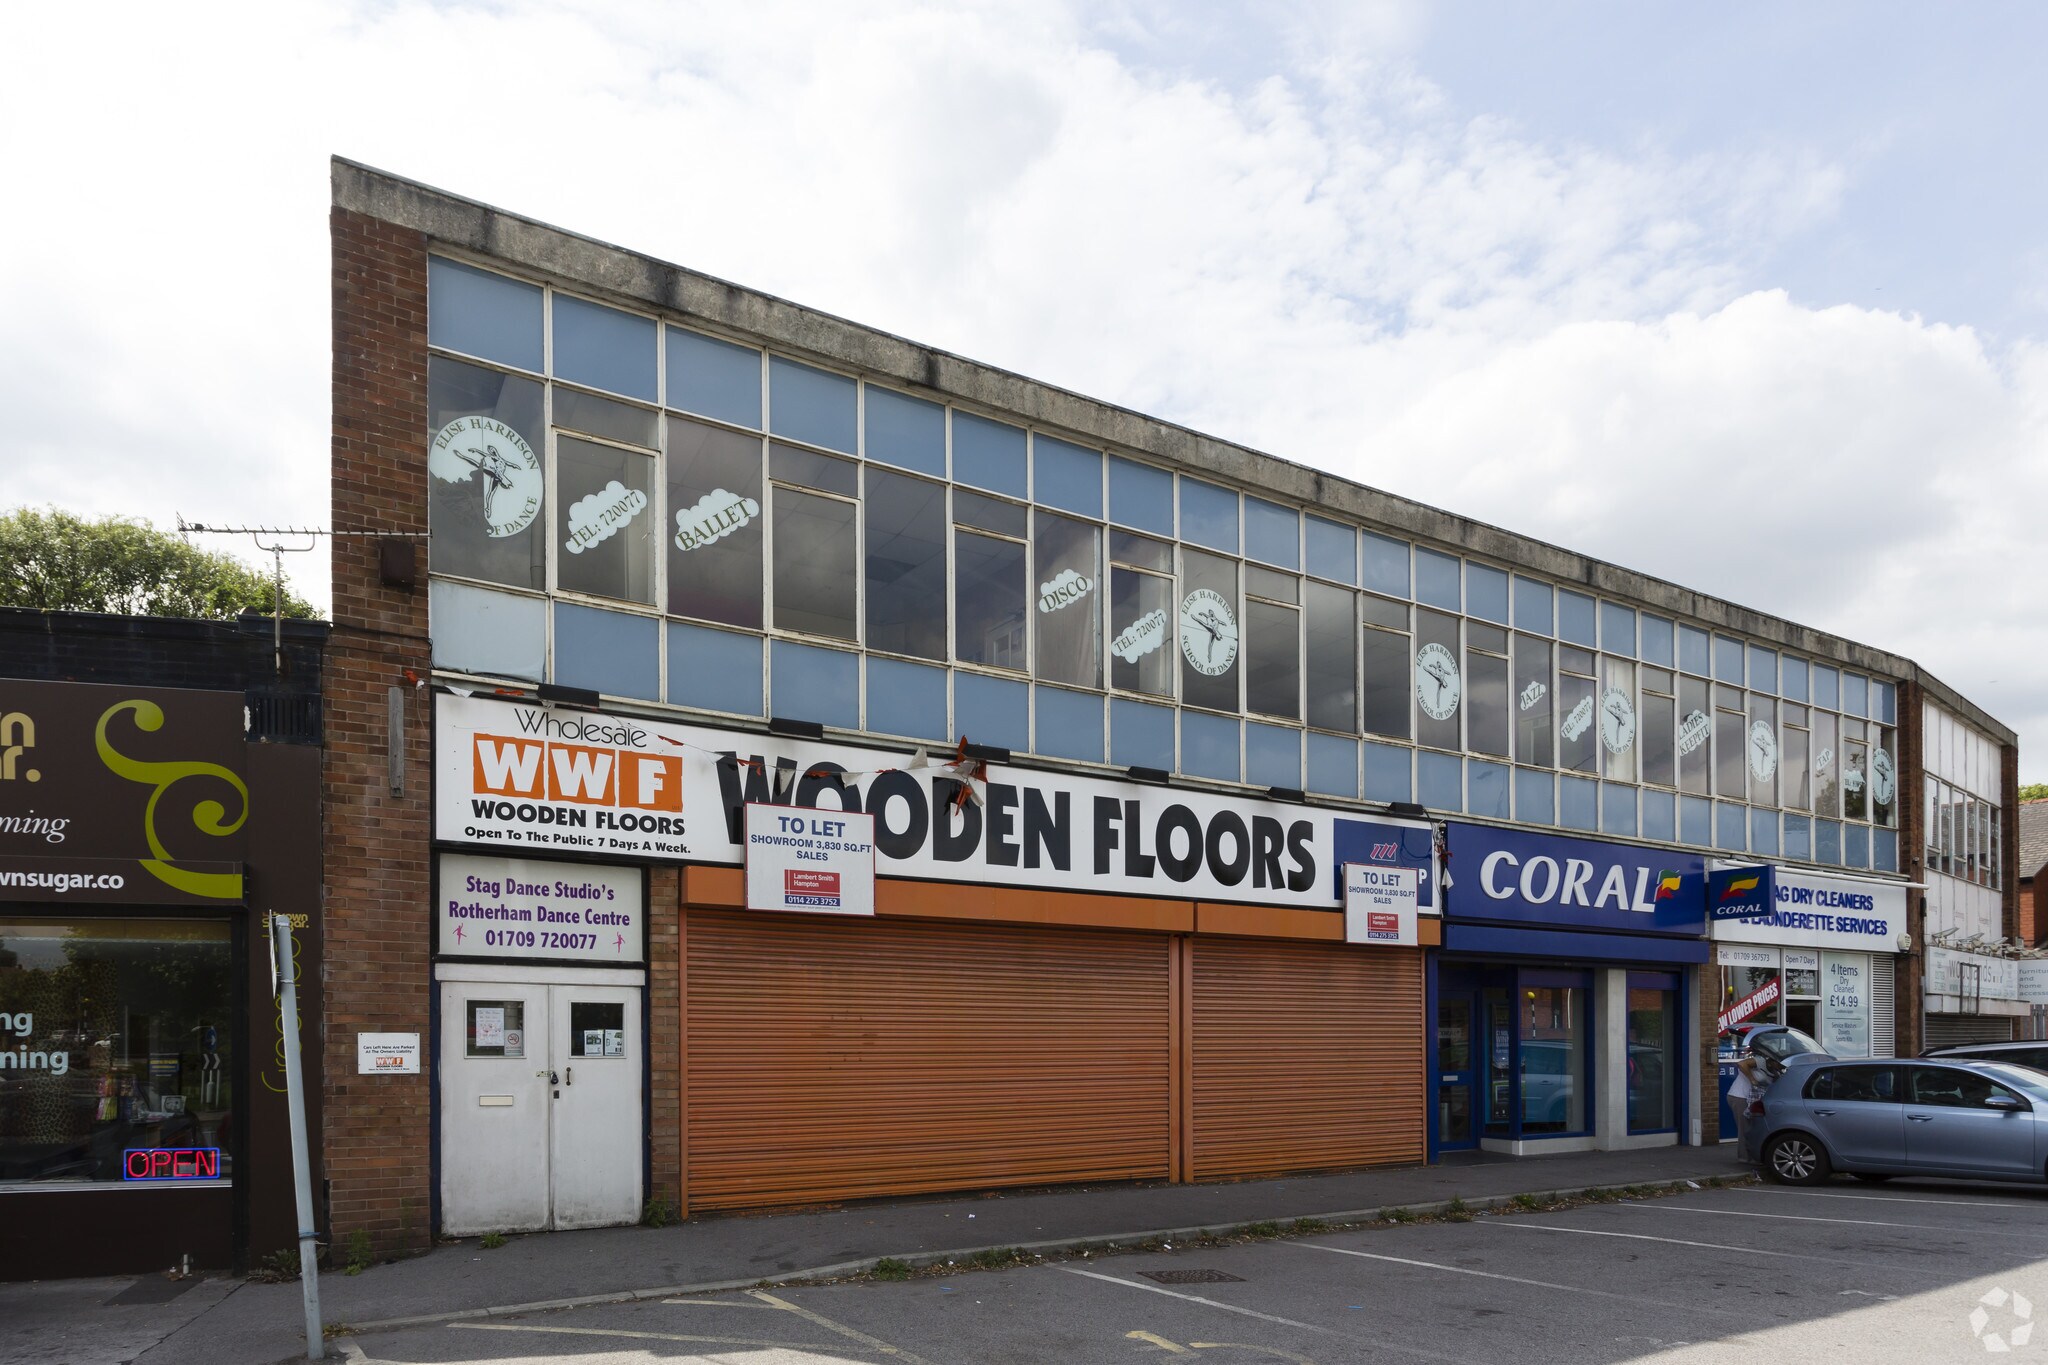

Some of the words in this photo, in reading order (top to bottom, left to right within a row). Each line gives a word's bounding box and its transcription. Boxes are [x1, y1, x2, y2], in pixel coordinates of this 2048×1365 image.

[435, 421, 466, 450] ELISE
[469, 418, 539, 471] HARRISON
[504, 496, 538, 534] DANCE
[570, 523, 601, 548] TEL:
[599, 491, 642, 527] 720077
[677, 498, 751, 550] BALLET
[1042, 575, 1088, 611] DISCO
[1181, 593, 1198, 615] ELISE
[1199, 590, 1236, 626] HARRISON
[1114, 634, 1137, 653] TEL:
[1136, 612, 1166, 639] 720077
[1182, 634, 1205, 673] SCHOOL
[1207, 667, 1217, 675] OF
[1217, 645, 1236, 674] DANCE
[1416, 648, 1428, 667] ELISE
[1429, 644, 1459, 675] HARRISON
[1416, 684, 1435, 717] SCHOOL
[1436, 711, 1444, 719] OF
[1444, 691, 1459, 717] DANCE
[1521, 684, 1544, 710] JAZZ
[514, 708, 648, 748] Wholesale
[1817, 750, 1830, 767] TAP
[476, 740, 667, 805] WWF
[471, 799, 587, 828] WOODEN
[596, 811, 686, 836] FLOORS
[778, 816, 805, 834] TO
[811, 820, 846, 838] LET
[464, 826, 502, 840] Open
[506, 829, 522, 841] To
[526, 831, 550, 843] The
[553, 833, 594, 847] Public
[598, 837, 605, 848] 7
[610, 838, 639, 851] Days
[642, 840, 652, 851] A
[655, 842, 692, 854] Week.
[750, 834, 814, 848] SHOWROOM
[816, 840, 842, 851] 3,830
[843, 842, 872, 854] SQ.FT
[1093, 795, 1317, 893] FLOORS
[796, 850, 829, 861] SALES
[466, 875, 501, 898] Stag
[506, 878, 550, 897] Dance
[554, 881, 615, 901] Studio's
[793, 873, 818, 881] Lambert
[818, 874, 835, 882] Smith
[793, 880, 820, 888] Hampton
[1363, 871, 1379, 885] TO
[1382, 873, 1401, 887] LET
[1480, 850, 1659, 914] CORAL
[788, 896, 805, 904] 0114
[805, 897, 819, 905] 275
[820, 898, 838, 906] 3752
[1348, 885, 1384, 895] SHOWROOM
[1384, 888, 1399, 897] 3,830
[1399, 890, 1416, 898] SQ.FT
[1373, 896, 1392, 905] SALES
[1792, 887, 1814, 905] DRY
[1815, 890, 1874, 912] CLEANERS
[449, 901, 532, 922] Rotherham
[537, 906, 580, 925] Dance
[585, 908, 630, 926] Centre
[1716, 903, 1763, 915] CORAL
[485, 929, 536, 947] 01709
[541, 932, 597, 949] 720077
[1836, 917, 1888, 936] SERVICES
[1734, 952, 1750, 960] 01709
[1785, 954, 1799, 963] Open
[1803, 956, 1815, 966] Days
[1830, 963, 1836, 975] 4
[1837, 963, 1858, 976] Items
[1840, 976, 1849, 986] Dry
[1830, 994, 1859, 1008] £14.99
[1833, 984, 1855, 994] Cleaned
[1727, 998, 1754, 1025] LOWER
[1753, 982, 1779, 1010] PRICES
[127, 1150, 216, 1178] OPEN
